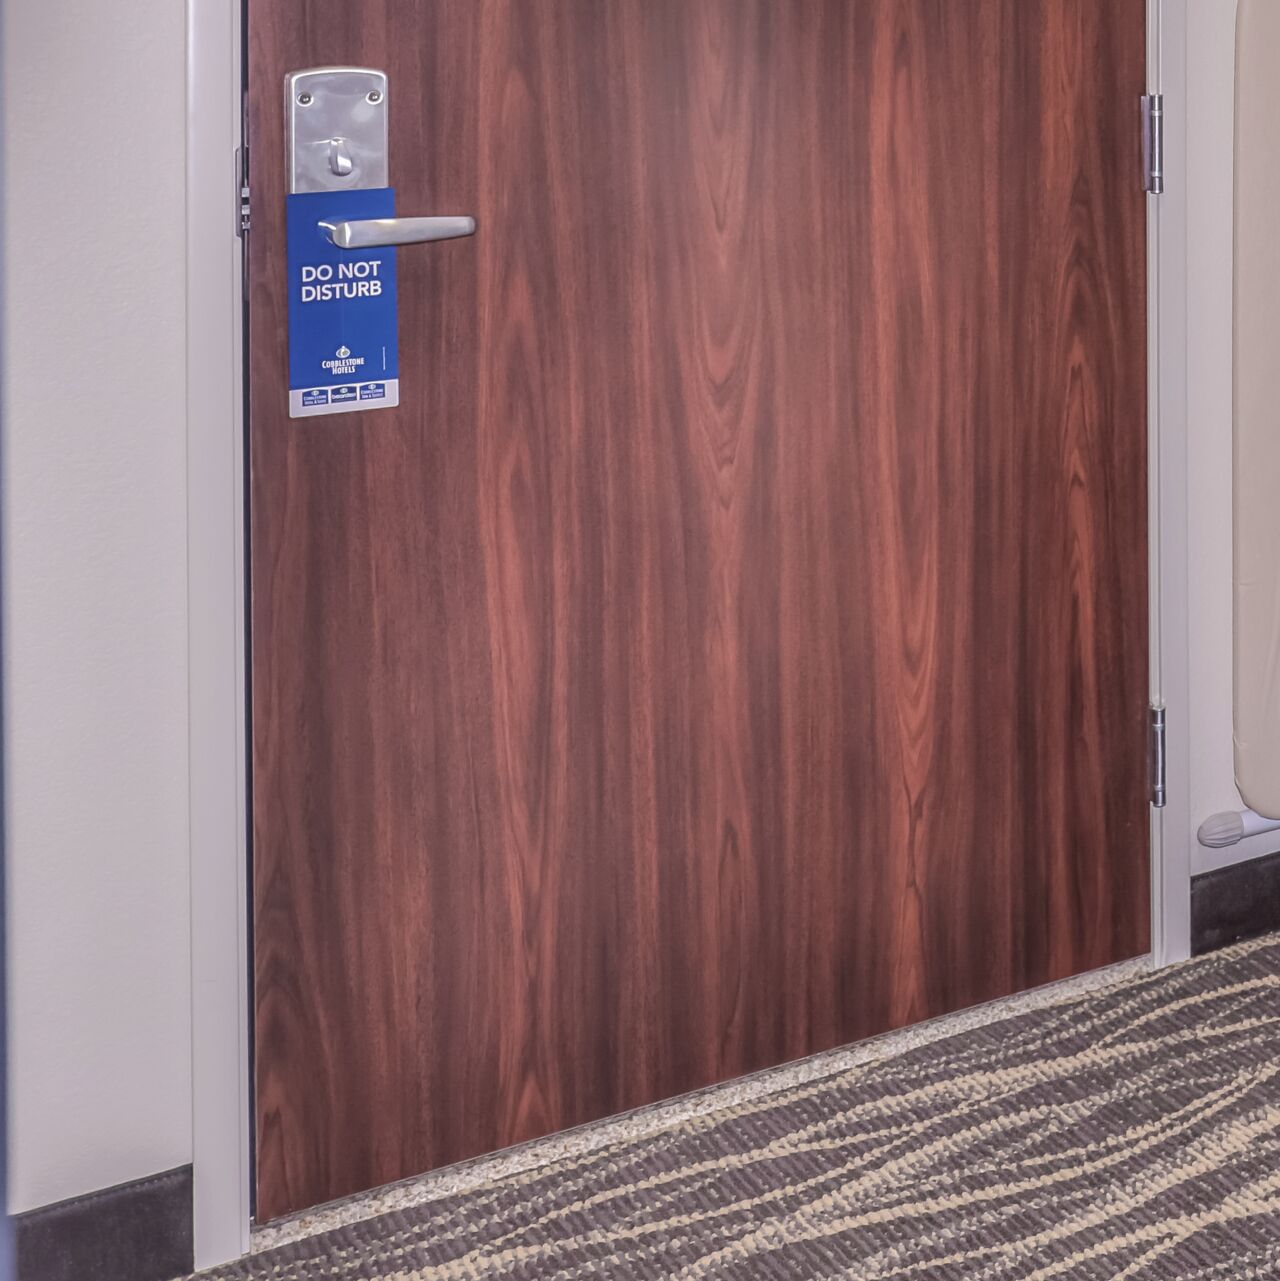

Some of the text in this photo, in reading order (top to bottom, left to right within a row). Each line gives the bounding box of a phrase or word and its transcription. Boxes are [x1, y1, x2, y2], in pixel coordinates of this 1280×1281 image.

[301, 260, 382, 282] DO NOT
[301, 280, 382, 302] DISTURB
[321, 357, 365, 369] COBBLESTONE
[332, 366, 356, 375] HOTELS
